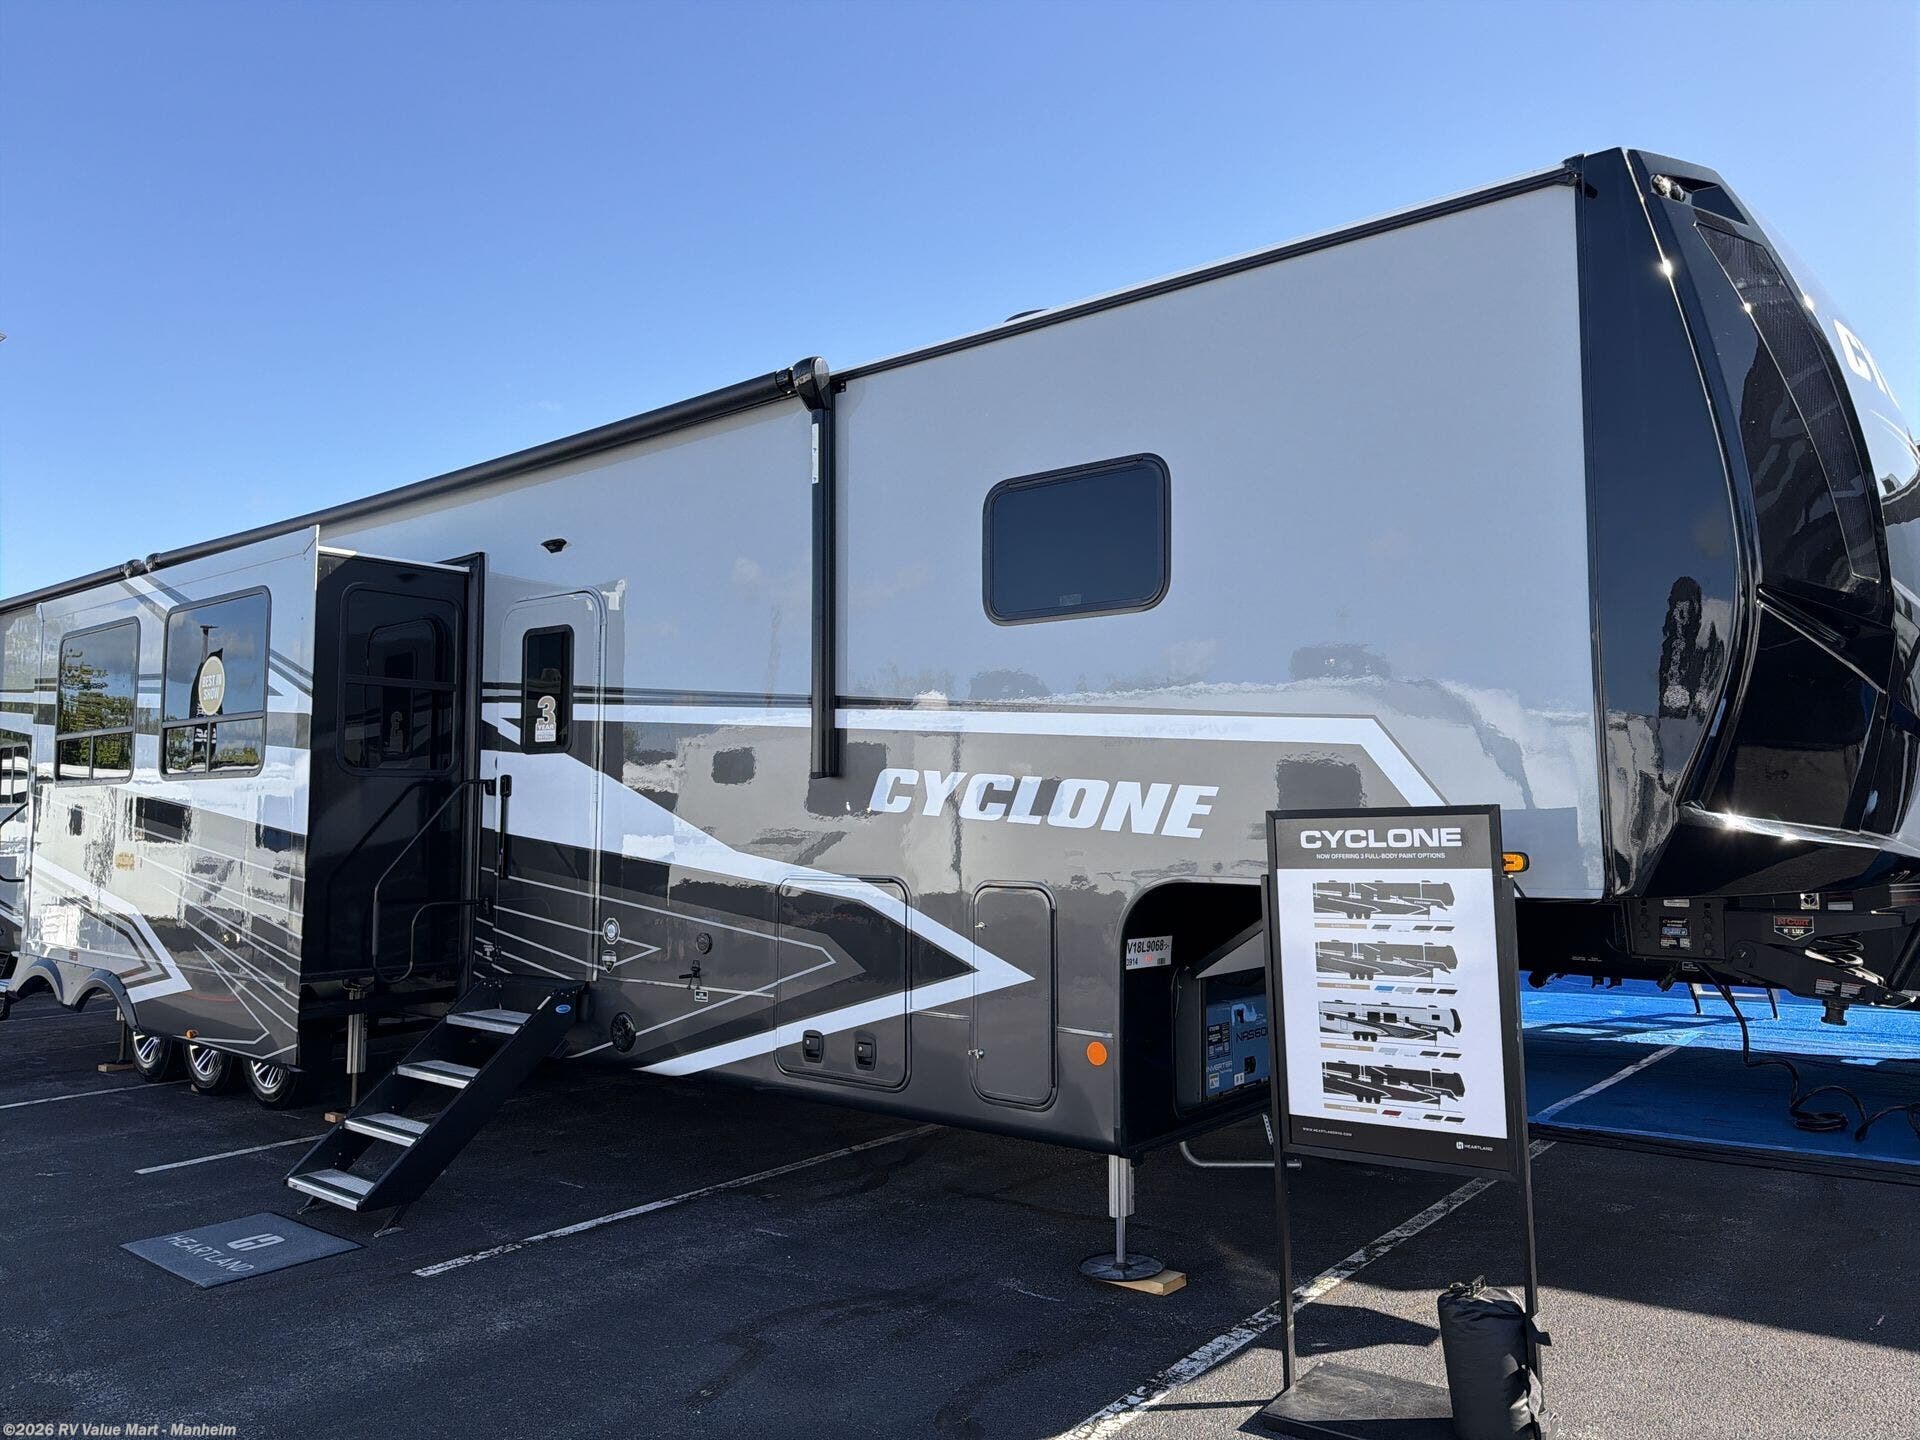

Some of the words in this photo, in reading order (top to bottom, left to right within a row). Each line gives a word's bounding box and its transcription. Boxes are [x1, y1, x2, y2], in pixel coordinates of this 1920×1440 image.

[202, 675, 215, 688] BEST
[203, 687, 219, 700] SHOW
[536, 695, 556, 725] 3
[868, 767, 1220, 839] CYCLONE
[1300, 828, 1462, 849] CYCLONE
[1463, 1144, 1494, 1152] HEARTLAND
[163, 1234, 255, 1272] HEARTLAND
